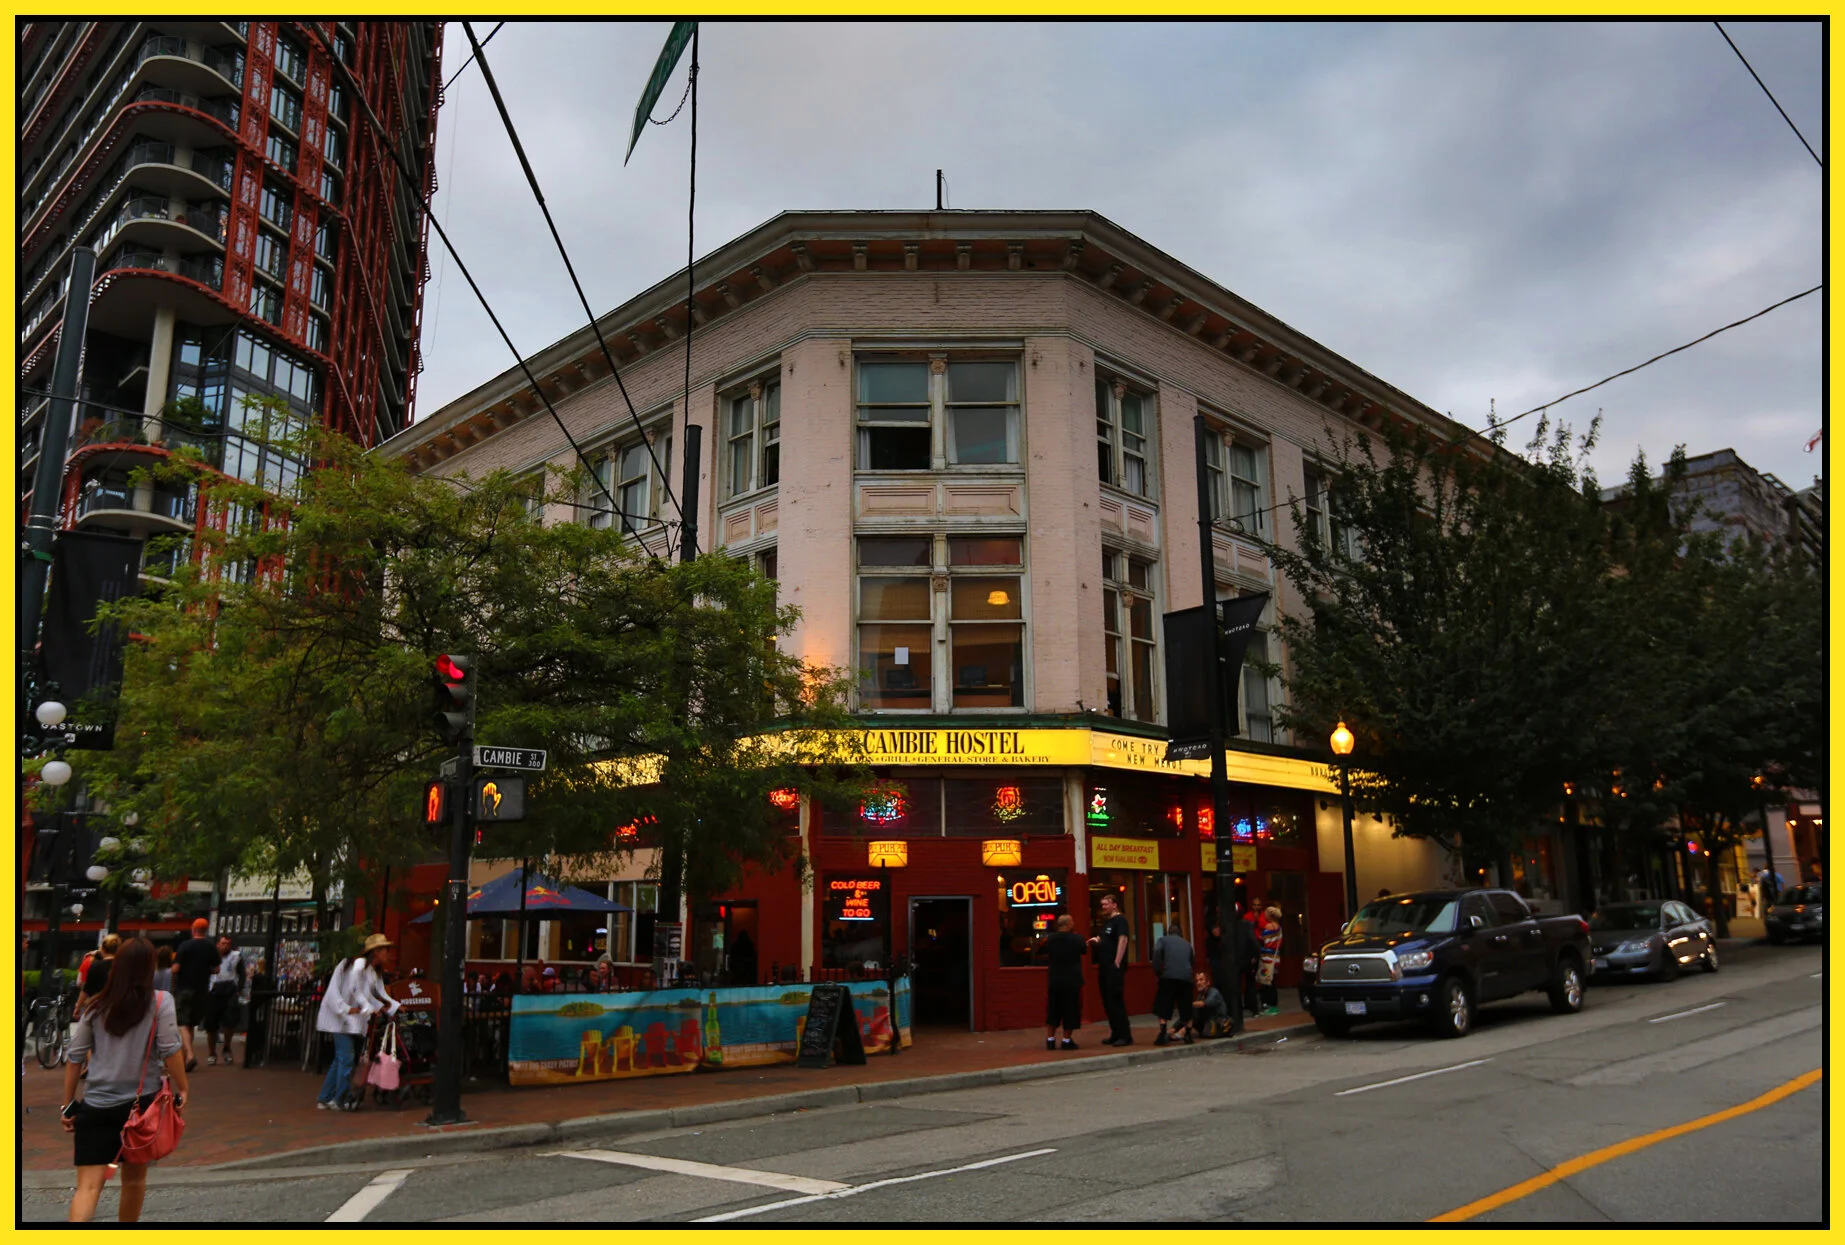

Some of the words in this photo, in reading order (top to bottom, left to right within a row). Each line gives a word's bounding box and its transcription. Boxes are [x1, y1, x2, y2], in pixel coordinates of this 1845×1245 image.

[41, 722, 103, 732] GASTOWN
[863, 731, 937, 754] CAMBIE
[945, 731, 1025, 754] HOSTEL
[1111, 739, 1135, 752] COME
[1142, 743, 1159, 755] TRY
[483, 749, 522, 765] CAMBIE
[881, 755, 911, 763] GRILL
[917, 755, 965, 763] GENERAL
[967, 755, 999, 763] STORE
[1001, 755, 1009, 763] &
[1011, 755, 1050, 763] BAKERY
[1127, 754, 1145, 765] NEW
[528, 760, 541, 768] 300
[1096, 843, 1108, 851] ALL
[830, 880, 856, 890] COLD
[856, 880, 881, 890] BEER
[1012, 881, 1057, 903] OPEN
[845, 898, 869, 907] WINE
[842, 908, 855, 917] TO
[855, 908, 871, 917] GO
